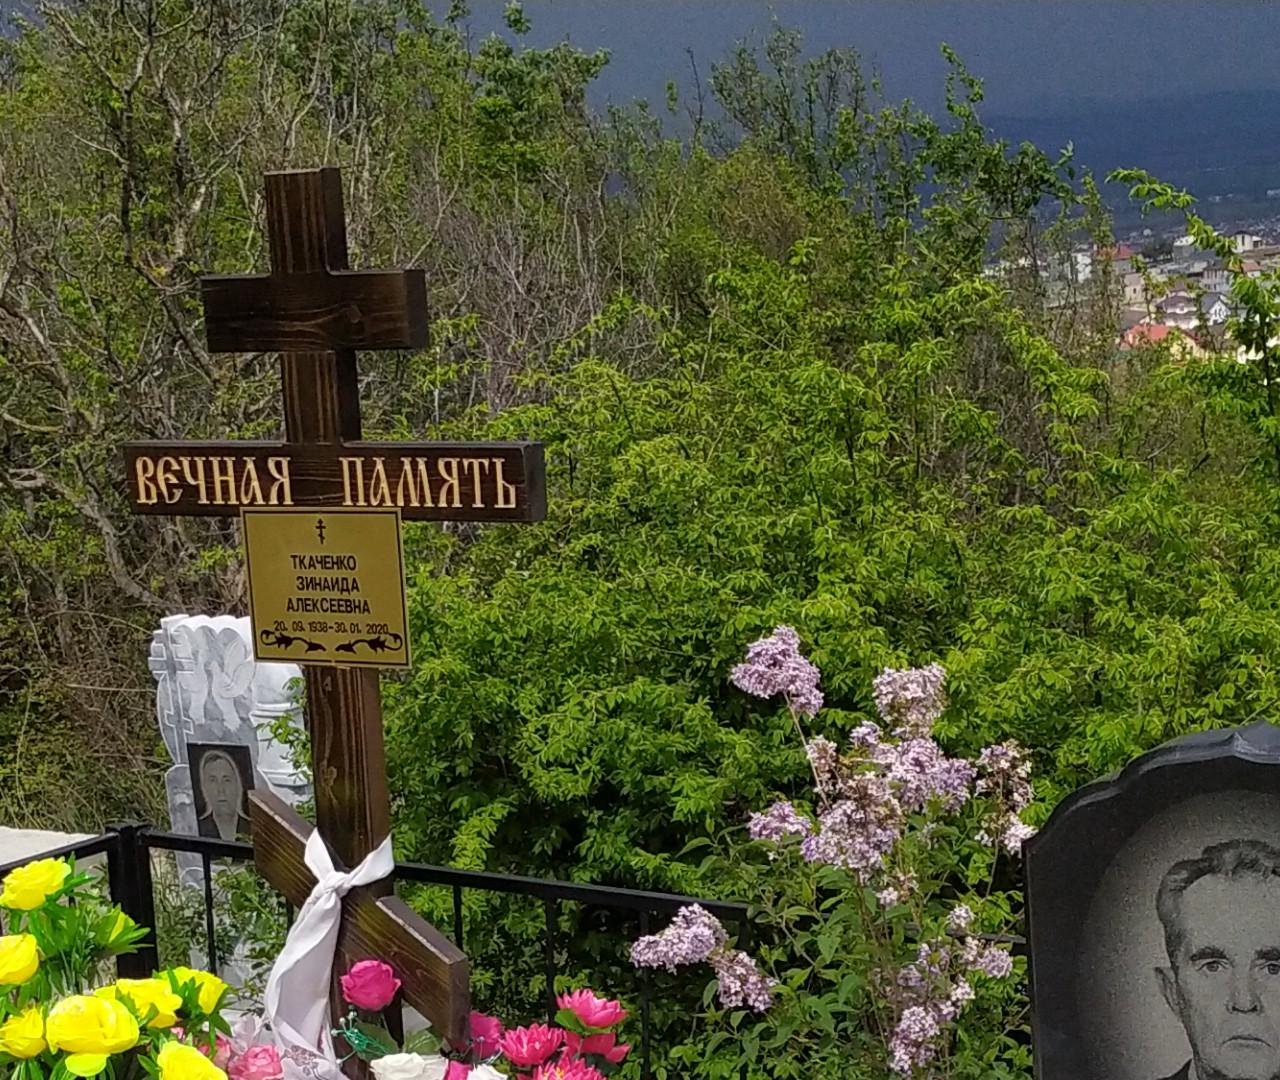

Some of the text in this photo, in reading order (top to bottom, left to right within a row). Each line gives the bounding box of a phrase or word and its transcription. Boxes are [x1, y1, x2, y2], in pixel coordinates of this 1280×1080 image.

[338, 456, 516, 508] ПАМЯТЬ
[290, 555, 357, 571] ТКАЧЕНКО
[296, 576, 360, 595] ЗИНАИДА
[286, 598, 371, 614] АЛЕКСЕЕВНА
